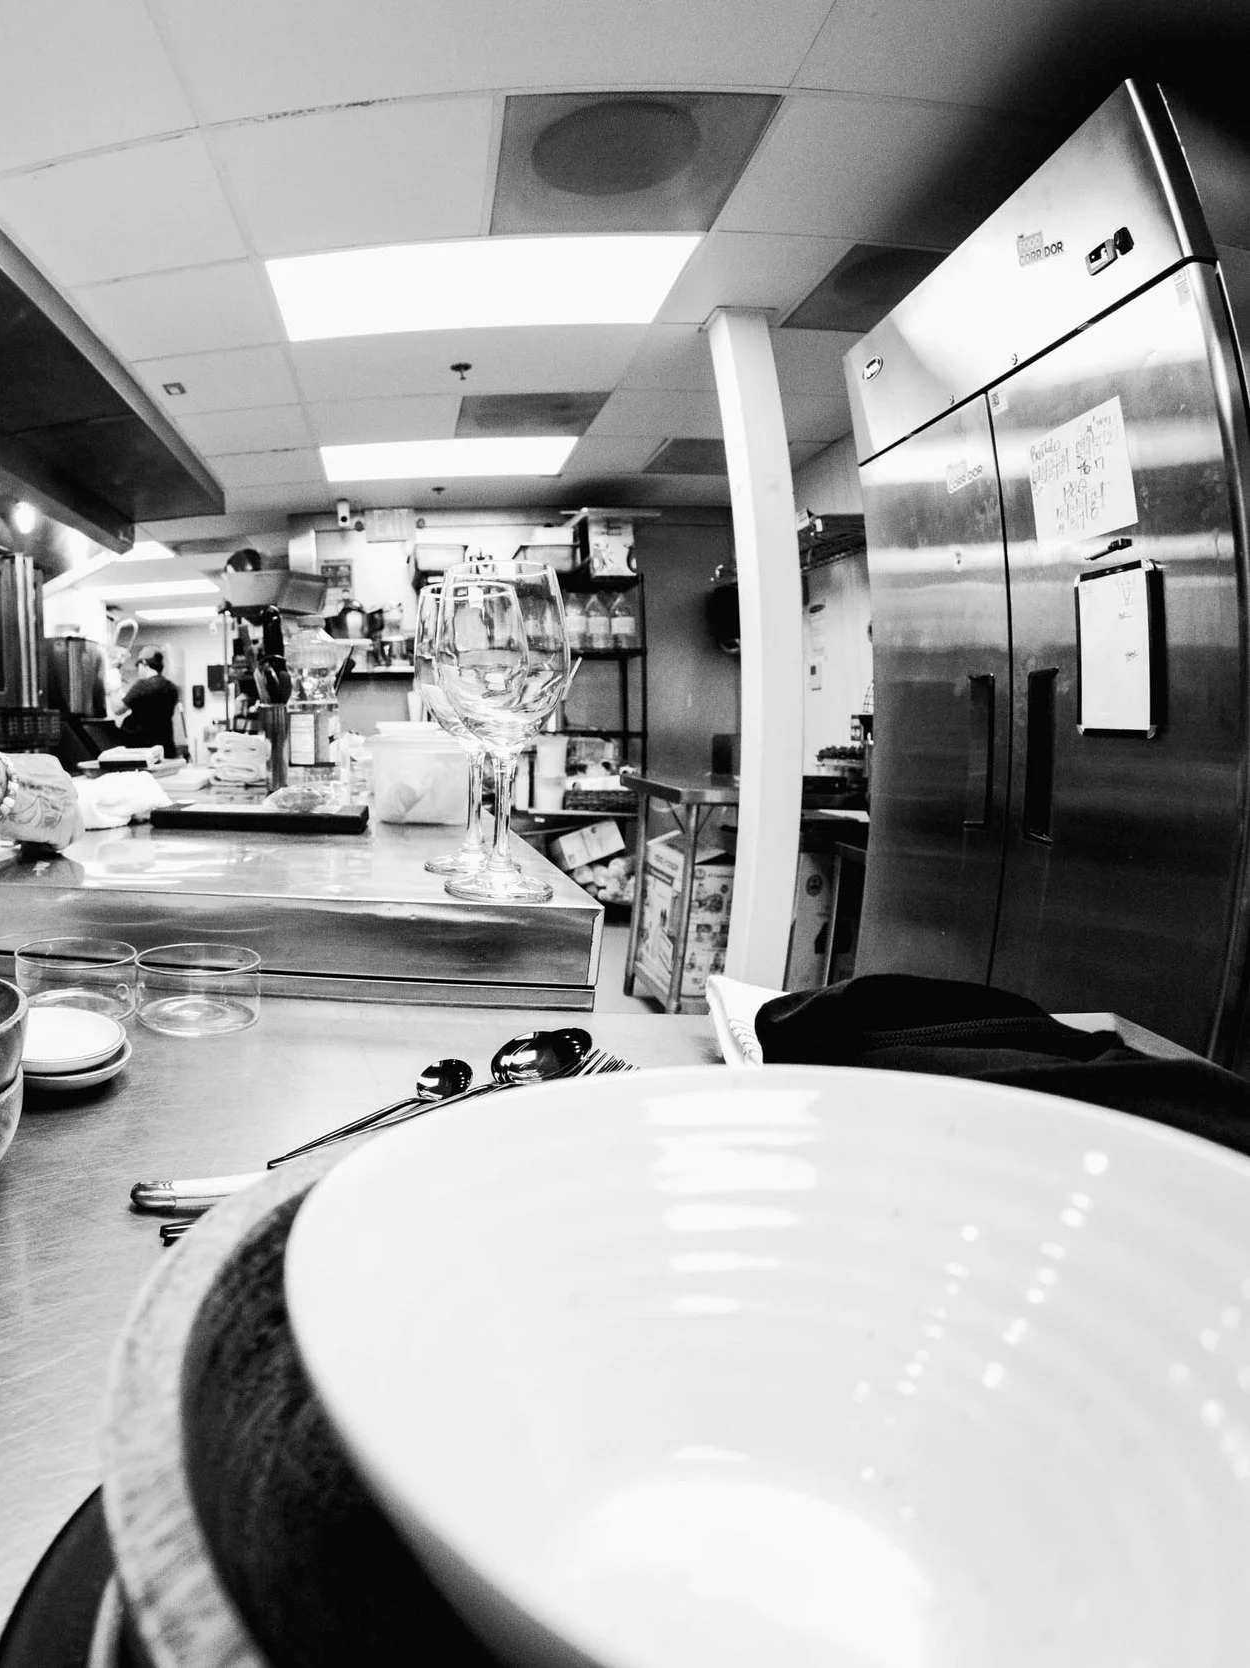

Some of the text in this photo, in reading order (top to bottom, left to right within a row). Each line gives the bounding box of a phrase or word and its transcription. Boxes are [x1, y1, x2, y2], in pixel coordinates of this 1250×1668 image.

[1019, 241, 1064, 267] CORRDOR
[949, 465, 983, 491] CORRDOR
[372, 509, 409, 538] EXIT
